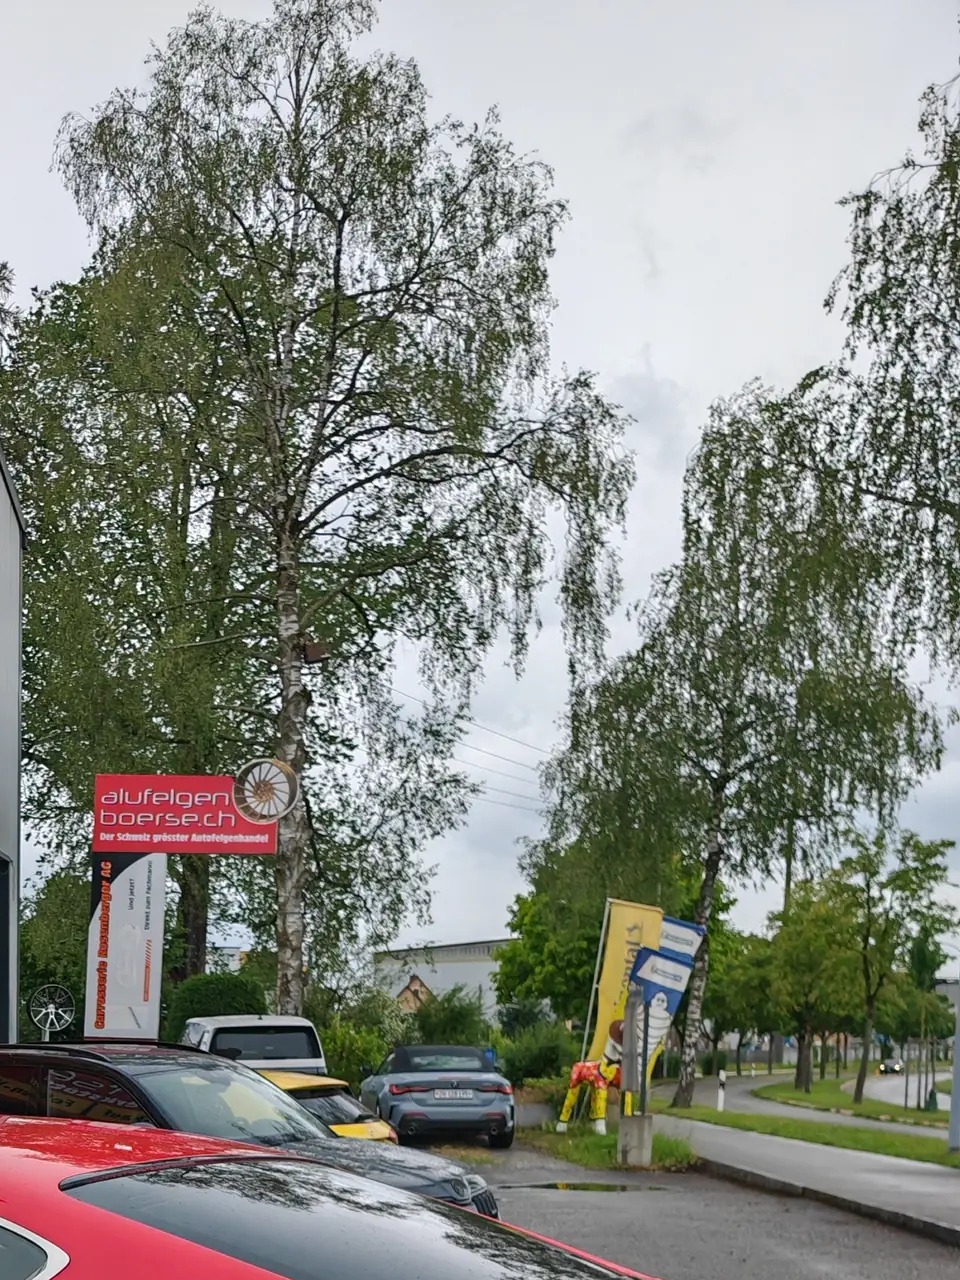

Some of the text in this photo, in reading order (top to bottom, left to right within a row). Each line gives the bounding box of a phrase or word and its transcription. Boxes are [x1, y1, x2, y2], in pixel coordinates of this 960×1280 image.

[100, 788, 230, 809] alufelgen
[99, 809, 236, 828] boerse.ch
[99, 832, 269, 844] Der Schweiz grösster Autofelgenhandel
[94, 860, 113, 1029] Carrosserie Rosenberger AG
